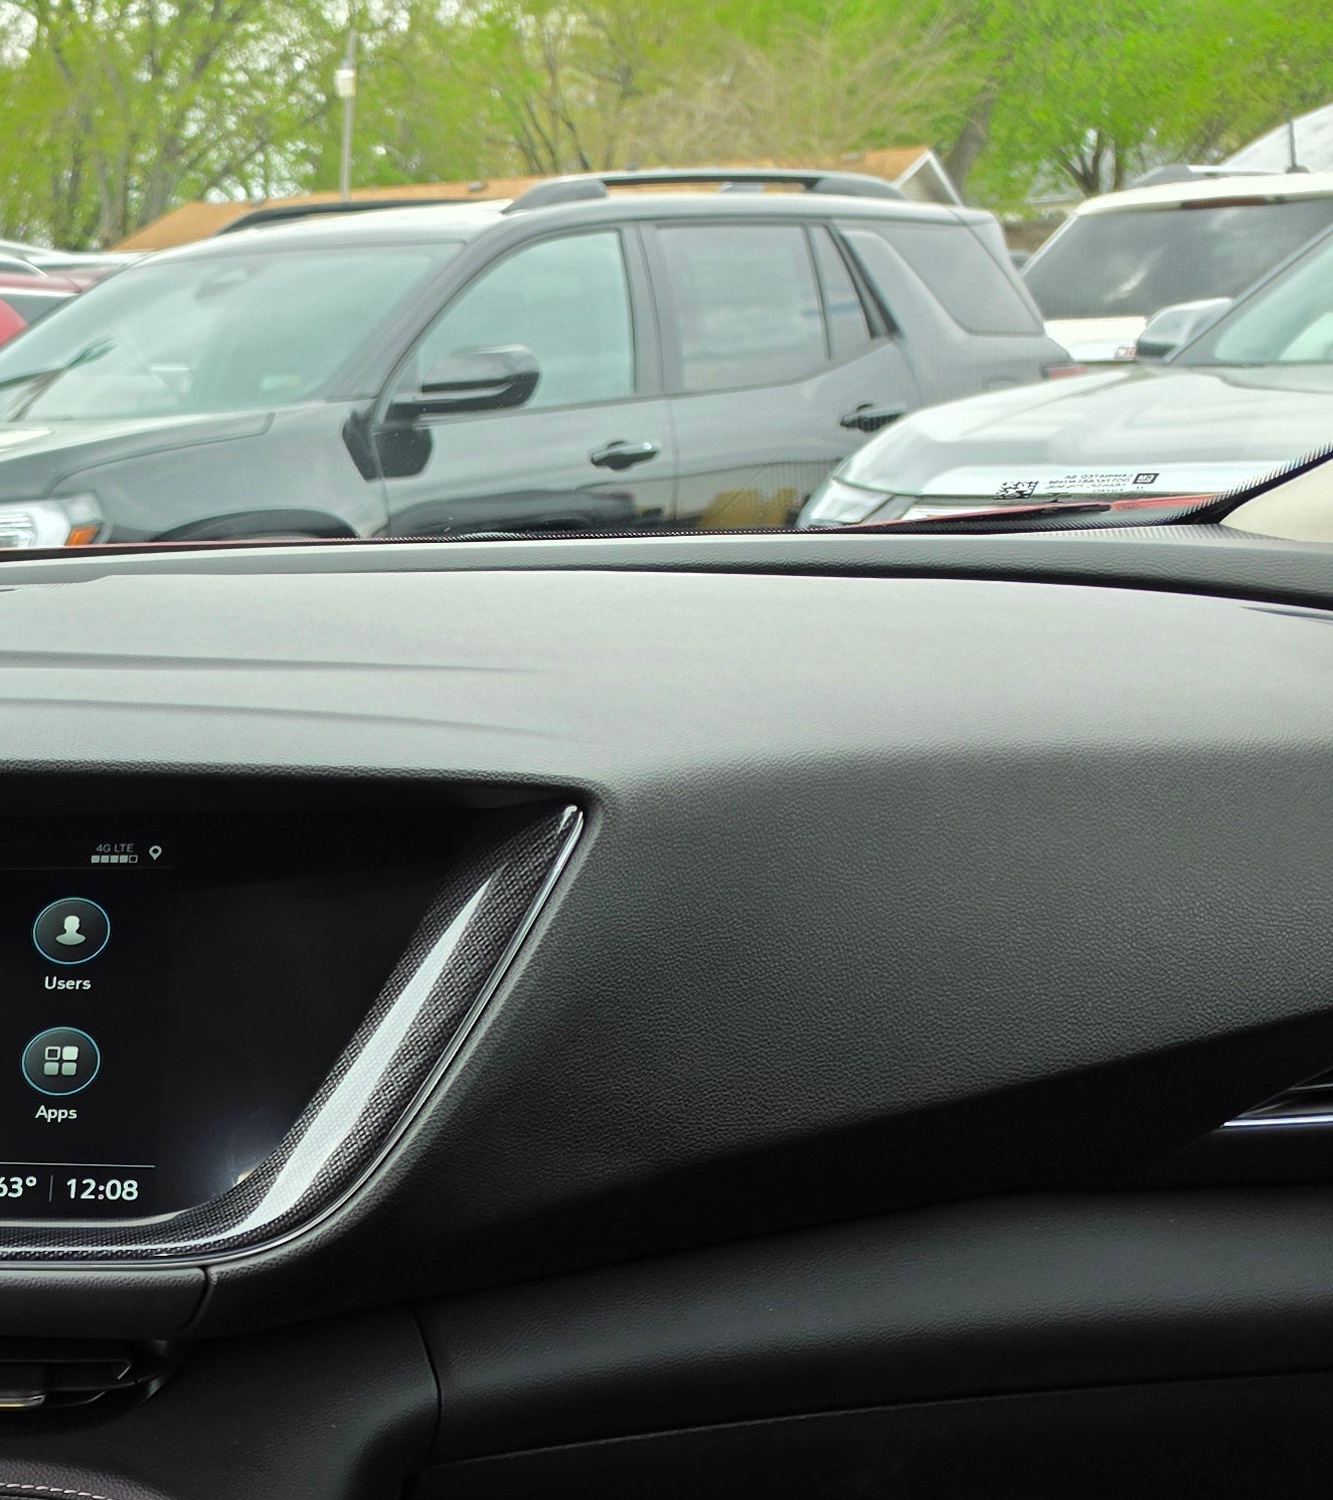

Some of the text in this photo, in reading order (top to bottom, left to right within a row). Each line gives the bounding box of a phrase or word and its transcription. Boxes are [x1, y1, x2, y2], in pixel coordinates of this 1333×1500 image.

[96, 843, 134, 853] 4G LTE
[44, 976, 91, 990] Users
[35, 1105, 77, 1122] Apps
[66, 1178, 139, 1200] 12:08
